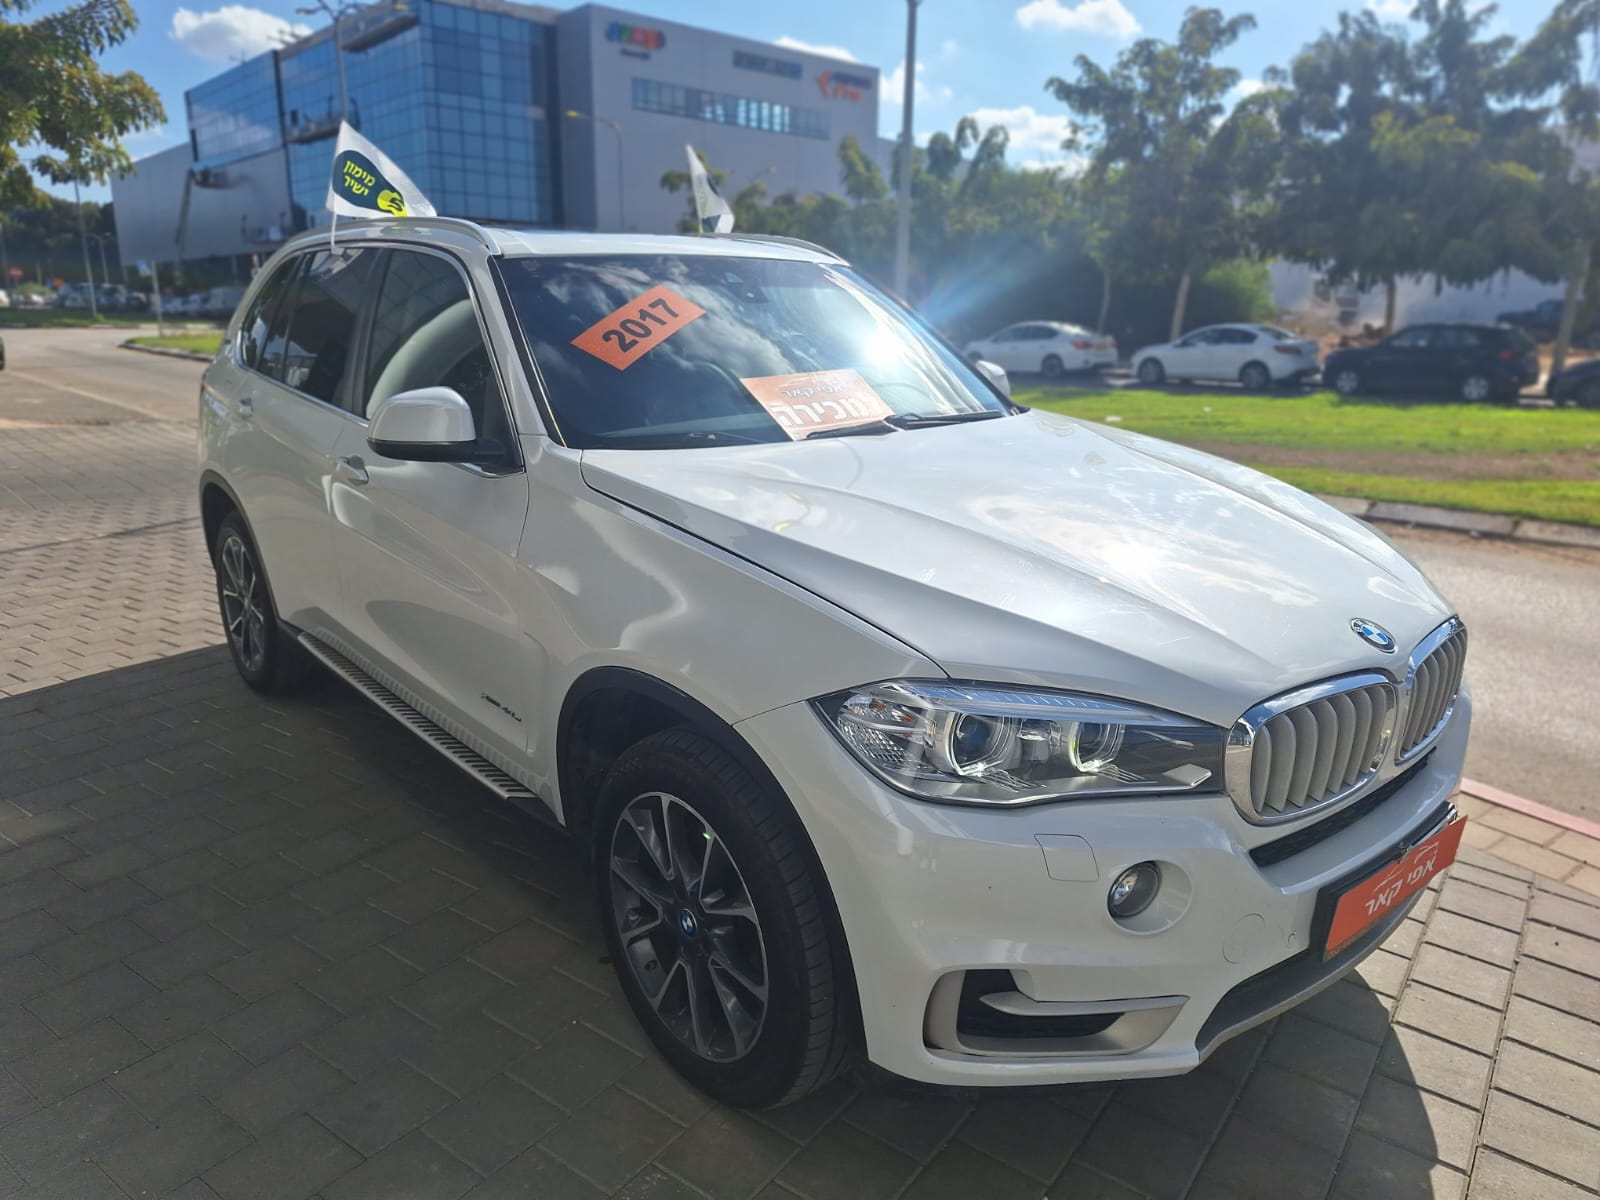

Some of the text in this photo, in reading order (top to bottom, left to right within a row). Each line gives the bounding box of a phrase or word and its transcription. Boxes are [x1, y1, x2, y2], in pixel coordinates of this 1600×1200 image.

[343, 160, 376, 187] מימון
[344, 175, 369, 196] ישיר
[602, 298, 679, 352] 2017
[1365, 858, 1434, 916] אפי קאר
